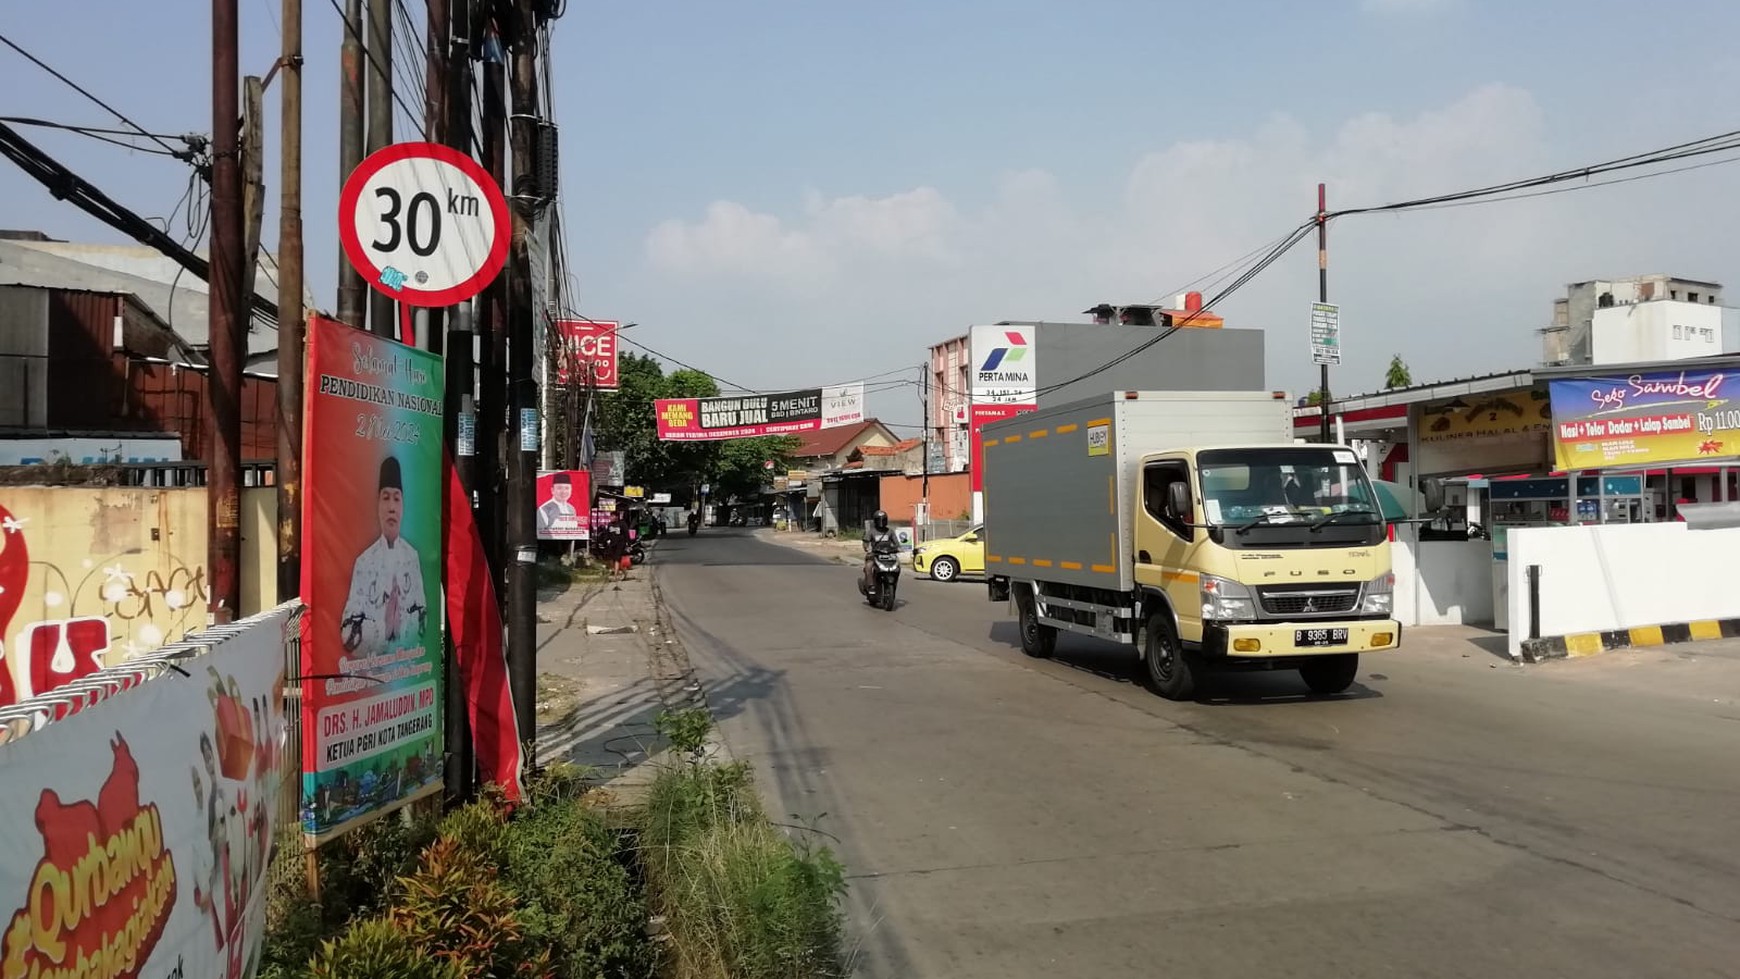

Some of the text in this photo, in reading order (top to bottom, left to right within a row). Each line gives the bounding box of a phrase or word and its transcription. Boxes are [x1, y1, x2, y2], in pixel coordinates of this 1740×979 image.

[371, 187, 479, 257] 30 km
[978, 372, 1029, 382] PERTAMINA
[320, 374, 443, 416] PENDIDIKAN NASIONAL
[1592, 371, 1724, 409] Sego Sambel
[667, 403, 687, 412] KAMI
[701, 397, 768, 412] BANGUN DULU
[771, 396, 818, 411] 5 MENIT
[790, 406, 818, 416] BINTARO
[830, 398, 856, 409] VIEW
[661, 411, 694, 420] MEMANG
[701, 409, 769, 428] BARU JUAL
[1488, 412, 1497, 421] 2
[668, 419, 688, 428] BEDA
[1560, 424, 1579, 438] Nasi
[1586, 422, 1605, 437] Telor
[1640, 418, 1662, 434] Lalap
[1662, 415, 1691, 430] Sambel
[1698, 412, 1713, 436] Rp
[1420, 431, 1473, 442] KULINER
[1476, 425, 1518, 437] HALAL
[1533, 423, 1552, 432] EN
[1264, 568, 1356, 577] FUSO
[1295, 627, 1349, 642] B 9365 BRV
[323, 711, 349, 738] DRS.
[352, 708, 362, 732] H.
[326, 713, 433, 764] KETUA PGRI KOTA TANGERANG
